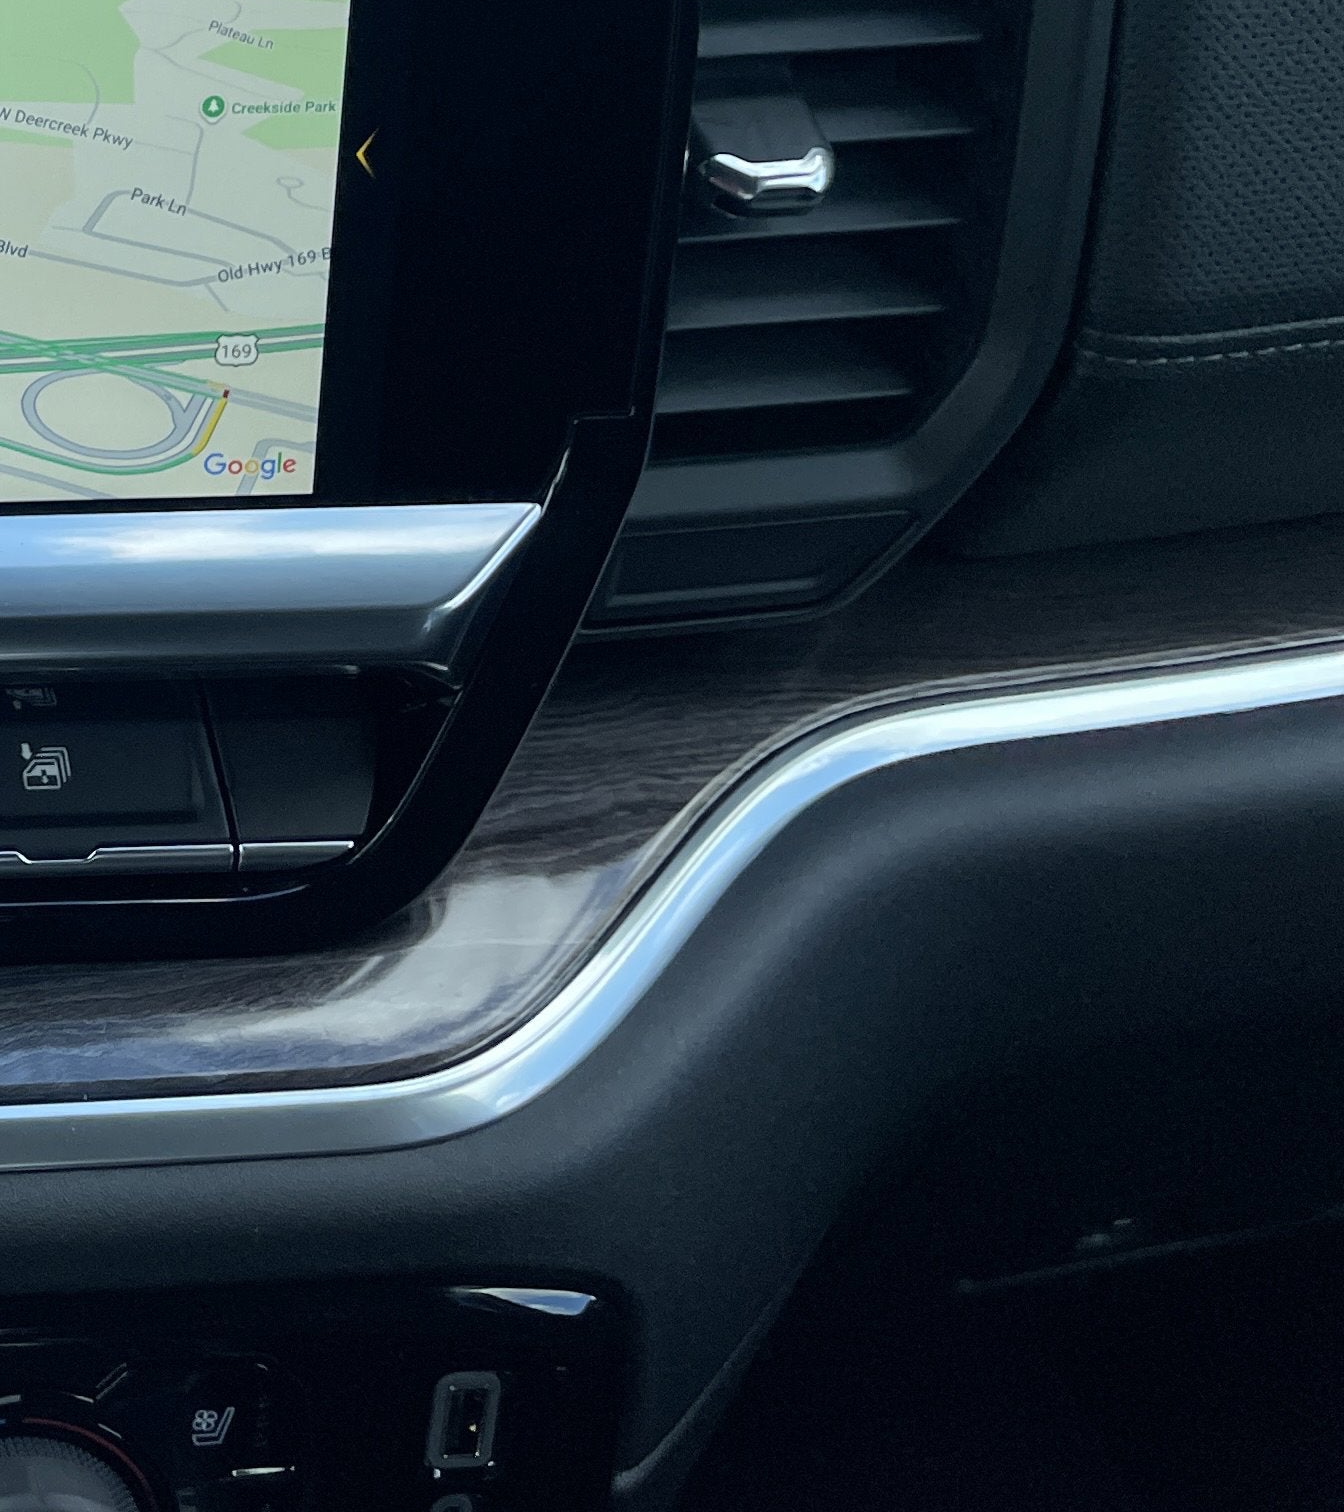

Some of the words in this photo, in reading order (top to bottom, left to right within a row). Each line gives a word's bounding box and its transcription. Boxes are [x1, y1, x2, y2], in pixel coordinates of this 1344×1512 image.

[209, 21, 255, 44] Plateau
[258, 38, 273, 48] Ln
[232, 101, 299, 114] Creekside
[305, 100, 335, 112] Park
[15, 112, 90, 136] Deercreek
[94, 128, 133, 148] Pkwy
[131, 188, 166, 208] Park
[168, 200, 186, 216] Ln
[222, 345, 251, 359] 169
[204, 452, 296, 480] Google
